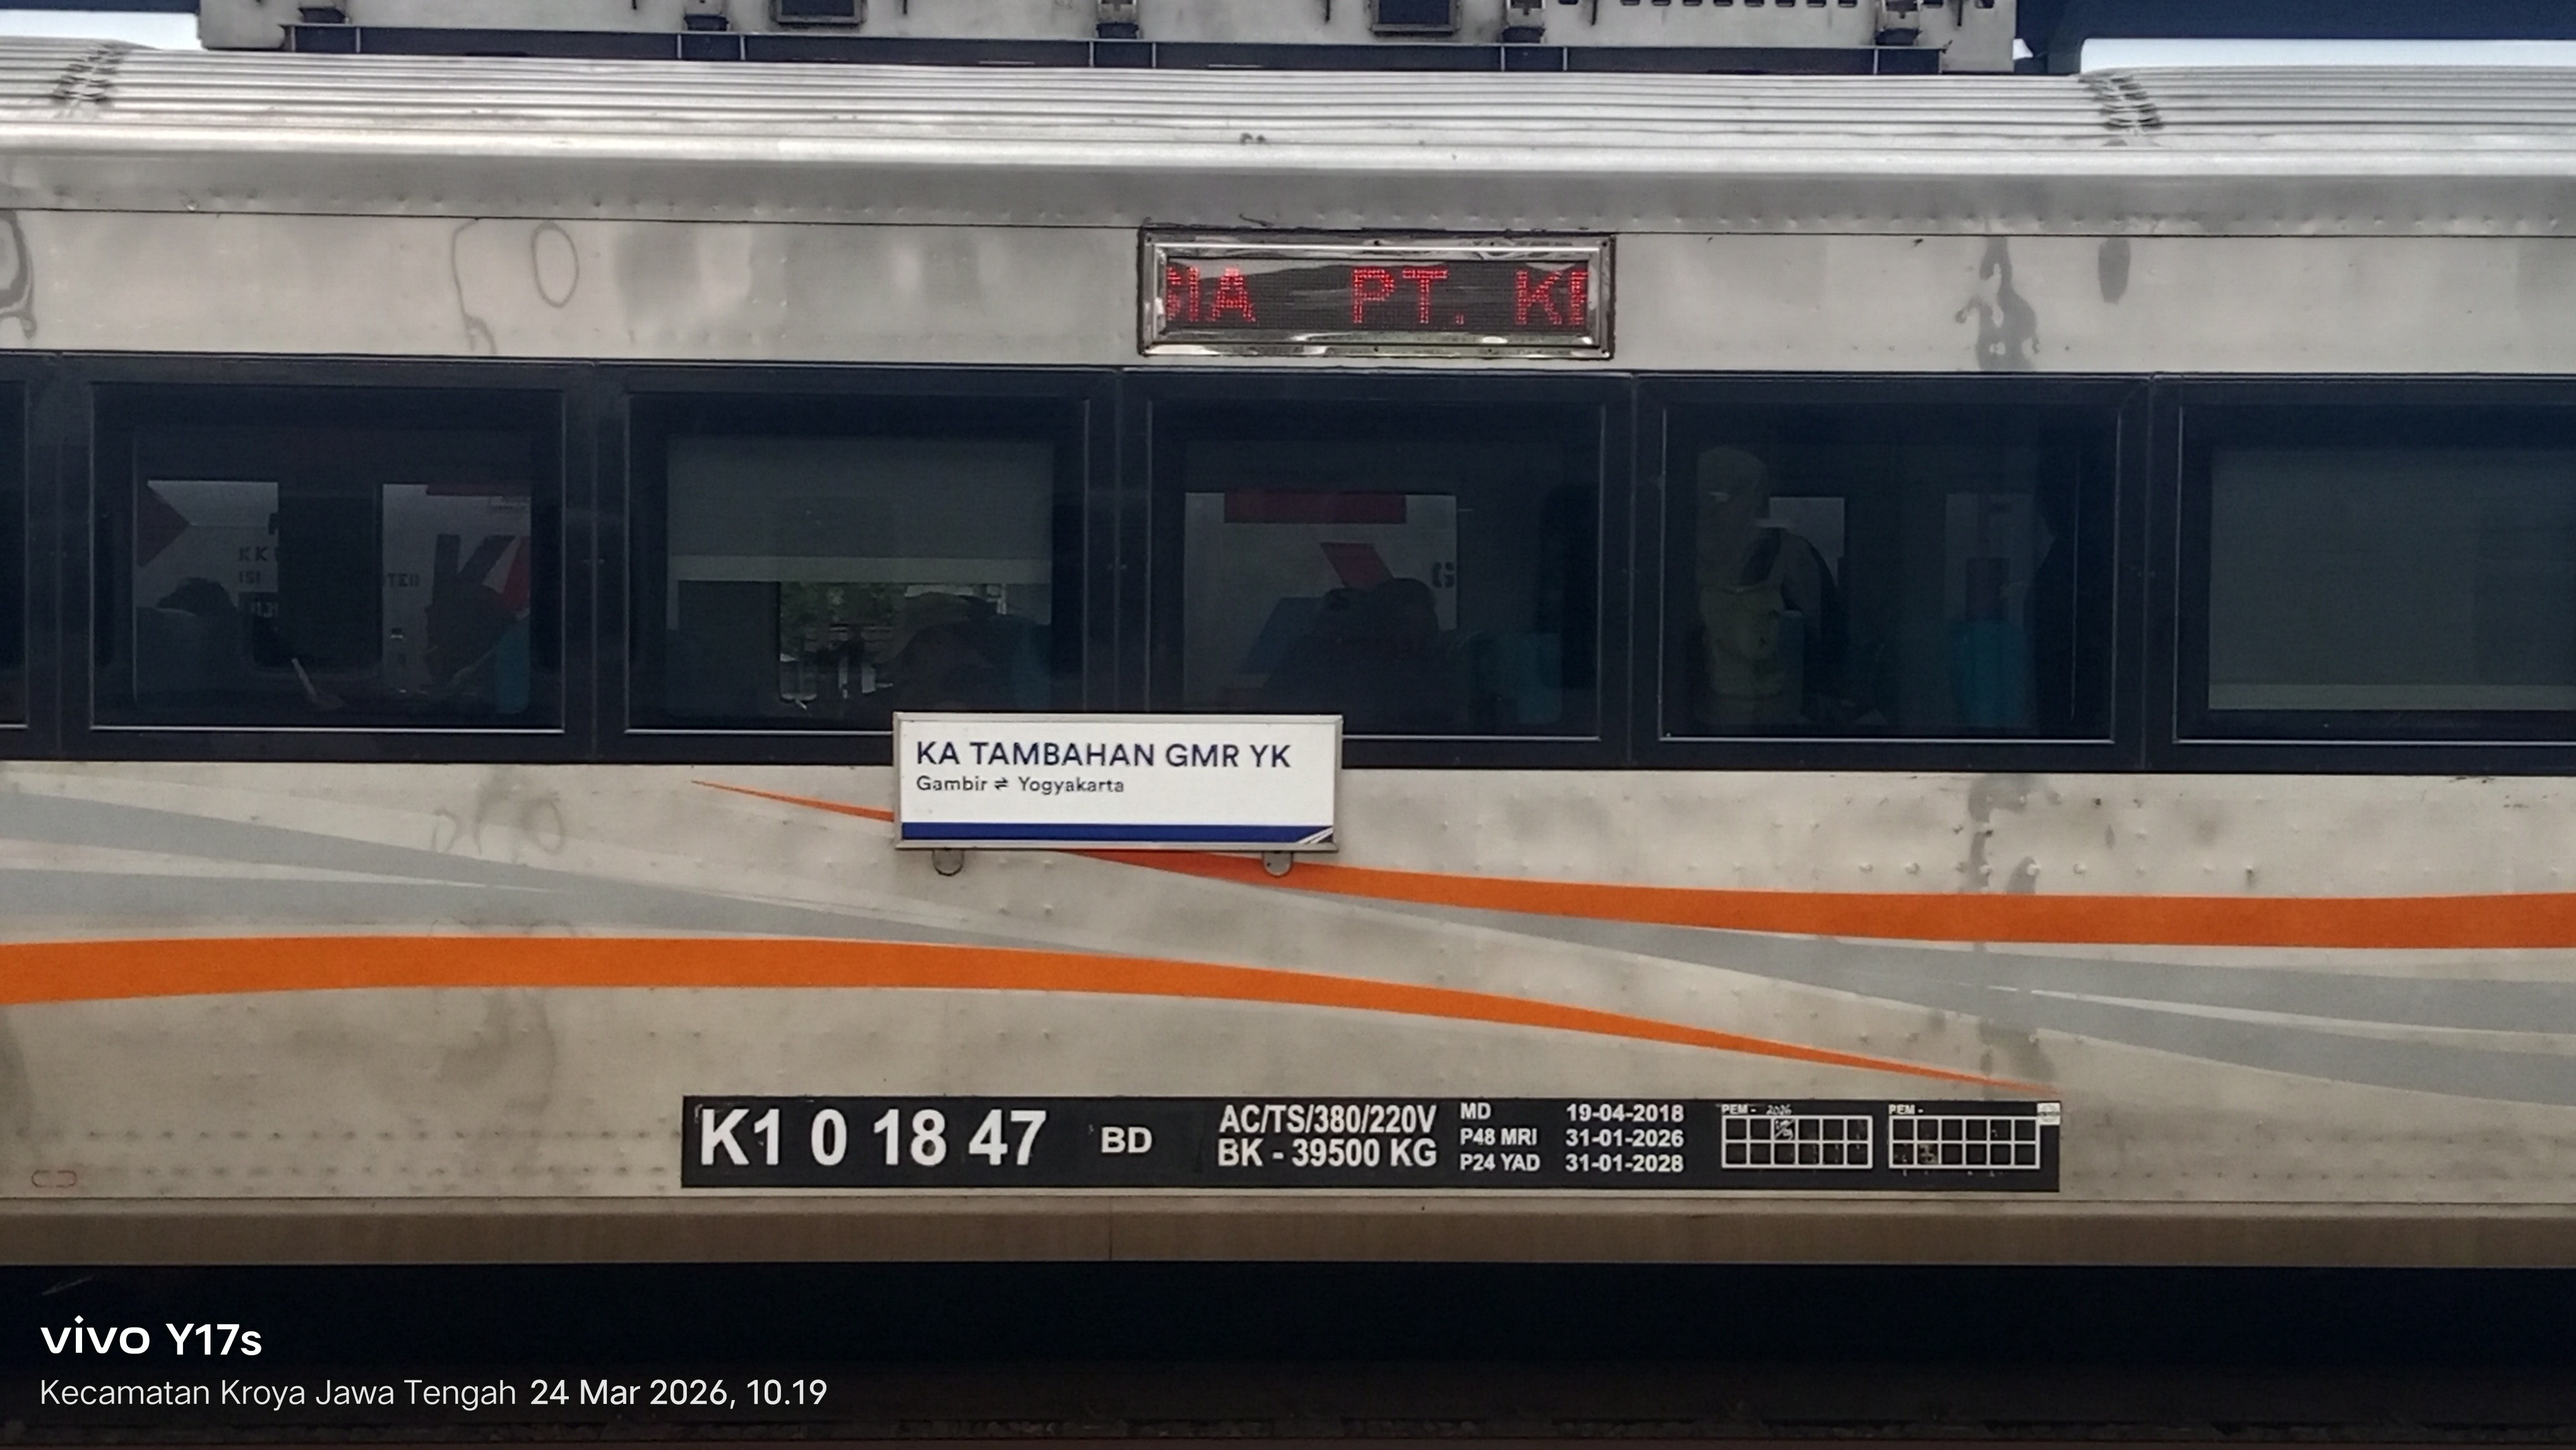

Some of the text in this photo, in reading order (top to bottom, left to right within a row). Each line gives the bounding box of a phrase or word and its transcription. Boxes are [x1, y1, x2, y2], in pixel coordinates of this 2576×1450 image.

[1351, 266, 1463, 325] PT.
[917, 741, 1291, 768] KA TAMBAHAN GMR YK
[916, 776, 1124, 796] Gambir Yogyakarta
[1219, 1104, 1437, 1134] AC/TS/380/220V
[1460, 1102, 1684, 1122] MD 19-04-2018
[1721, 1104, 1748, 1115] PEM
[1888, 1104, 1915, 1115] PEM
[700, 1109, 1047, 1166] K1 0 18 47
[1101, 1127, 1153, 1153] BD
[1460, 1127, 1684, 1147] P48 MRI 31-01-2026
[1218, 1138, 1263, 1166] BK
[1292, 1138, 1380, 1167] 39500
[1390, 1138, 1437, 1167] KG
[1460, 1153, 1684, 1173] P24 YAD 31-01-2028
